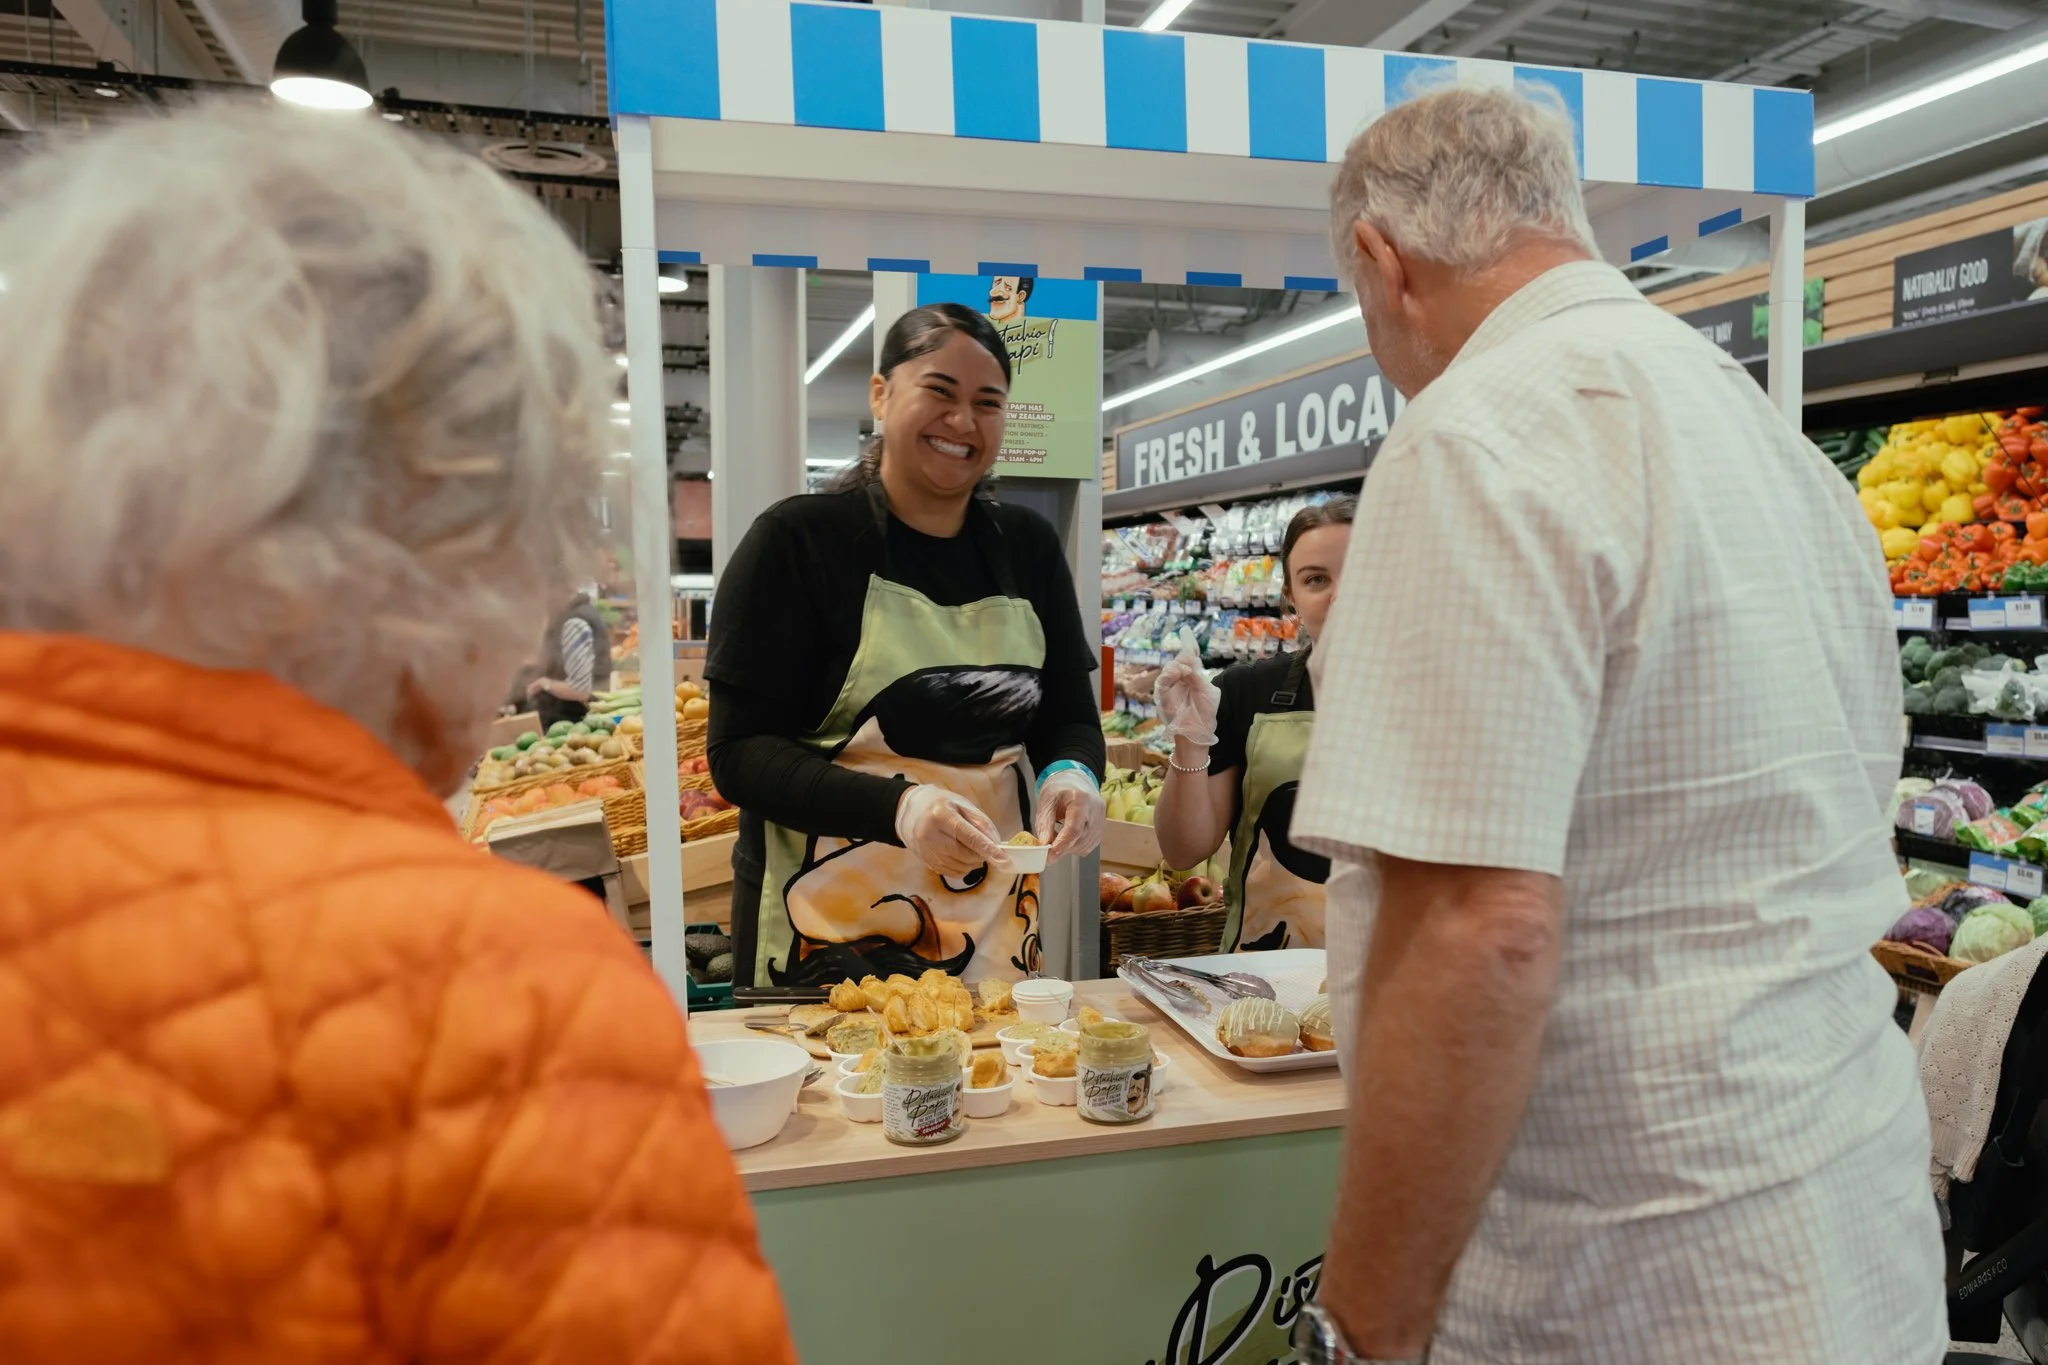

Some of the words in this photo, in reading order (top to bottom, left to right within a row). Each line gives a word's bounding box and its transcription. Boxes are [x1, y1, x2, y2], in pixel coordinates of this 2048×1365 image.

[1902, 265, 1958, 302] NATURALLY
[1959, 257, 1989, 288] GOOD
[998, 319, 1047, 346] tachio
[1007, 342, 1040, 375] api
[1005, 412, 1018, 420] EW
[1010, 403, 1028, 411] PAPI
[1134, 419, 1226, 488] FRESH
[1237, 410, 1262, 466] &
